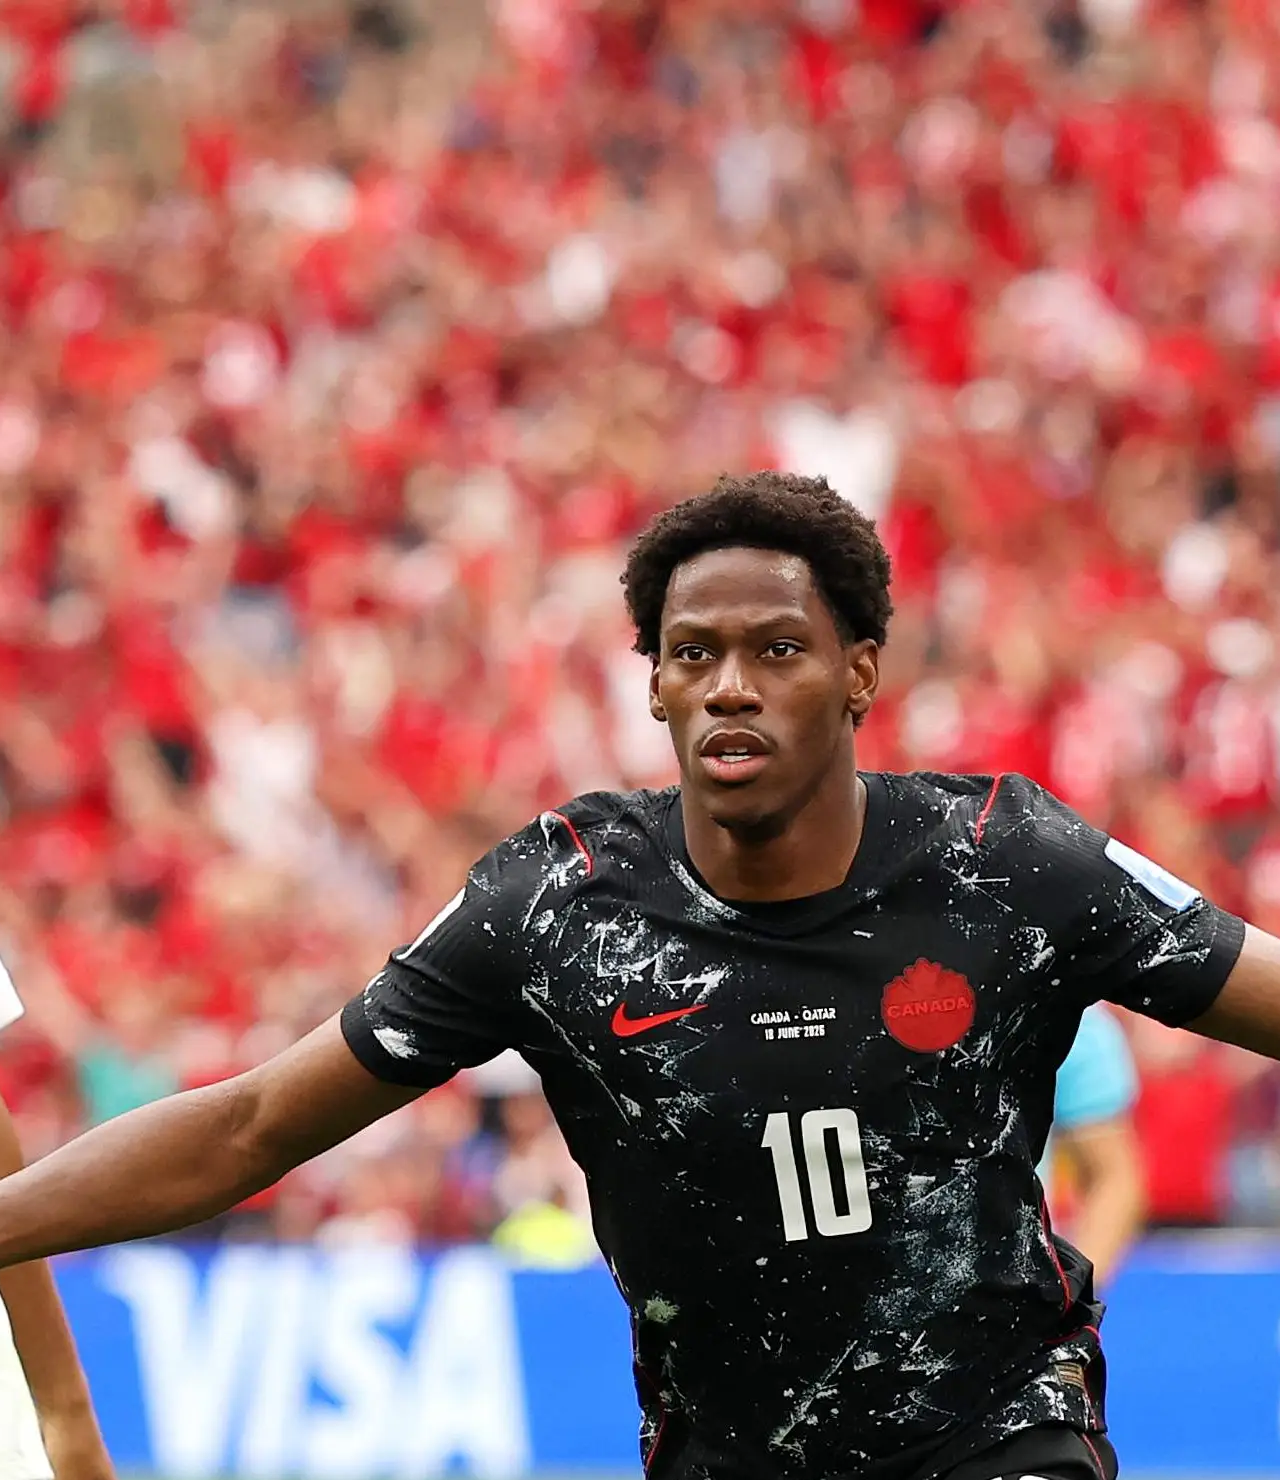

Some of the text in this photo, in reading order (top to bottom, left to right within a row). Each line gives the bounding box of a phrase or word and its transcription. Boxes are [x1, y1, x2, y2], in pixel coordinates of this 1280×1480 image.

[750, 1011, 791, 1025] CANADA
[802, 1007, 837, 1021] QATAR
[887, 996, 969, 1019] CANADA
[764, 1028, 774, 1041] 18
[777, 1026, 801, 1040] JUNE
[761, 1108, 873, 1242] 10
